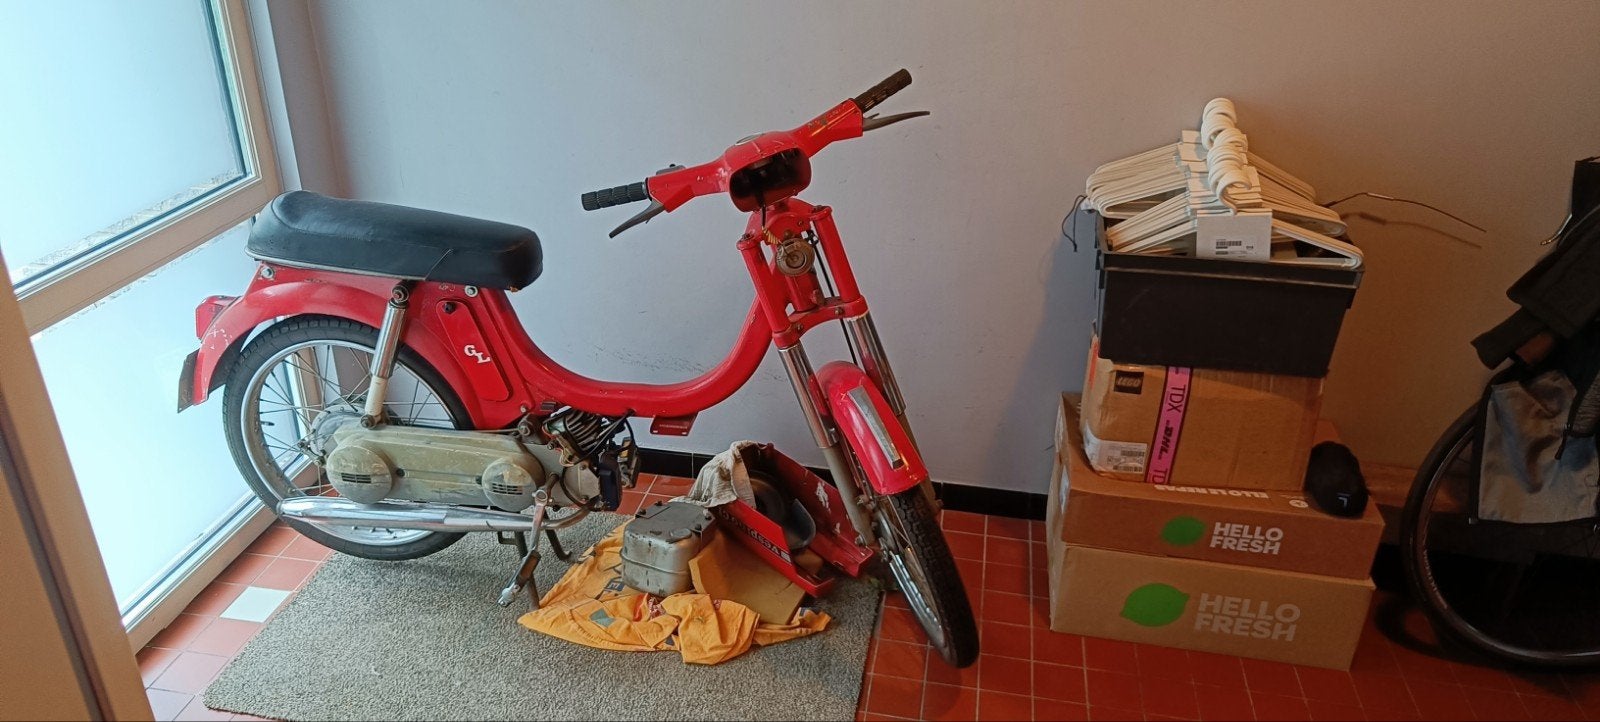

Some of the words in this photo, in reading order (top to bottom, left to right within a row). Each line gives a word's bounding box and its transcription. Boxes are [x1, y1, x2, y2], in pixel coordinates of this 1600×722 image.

[464, 344, 491, 364] GL
[1167, 384, 1186, 413] TDX
[1212, 521, 1284, 542] HELLO
[1210, 537, 1281, 555] FRESH
[1199, 593, 1301, 623] HELLO
[1195, 615, 1297, 642] FRESH
